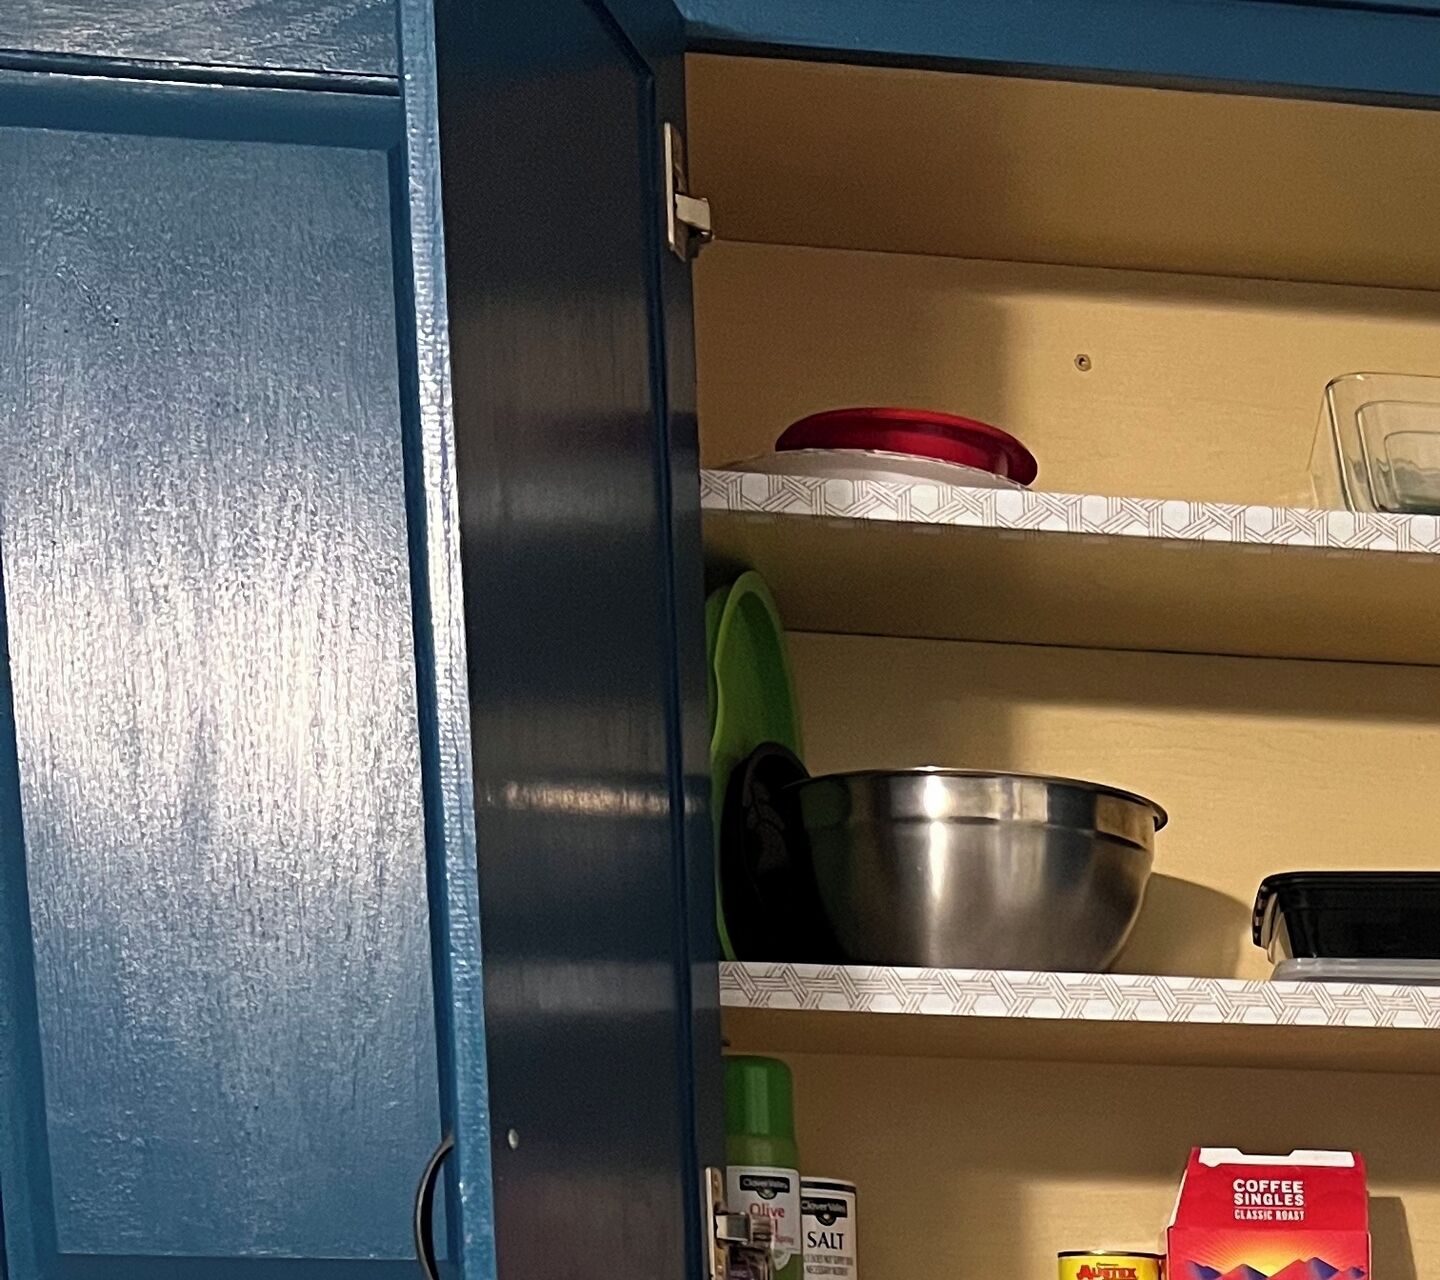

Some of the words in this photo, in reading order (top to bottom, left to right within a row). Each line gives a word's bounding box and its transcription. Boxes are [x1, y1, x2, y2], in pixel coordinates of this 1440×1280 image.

[1233, 1178, 1304, 1194] COFFEE
[1233, 1193, 1305, 1207] SINGLES
[750, 1202, 785, 1218] Olive
[1234, 1209, 1273, 1221] CLASSIC
[1276, 1209, 1304, 1221] ROAST
[807, 1230, 844, 1250] SALT
